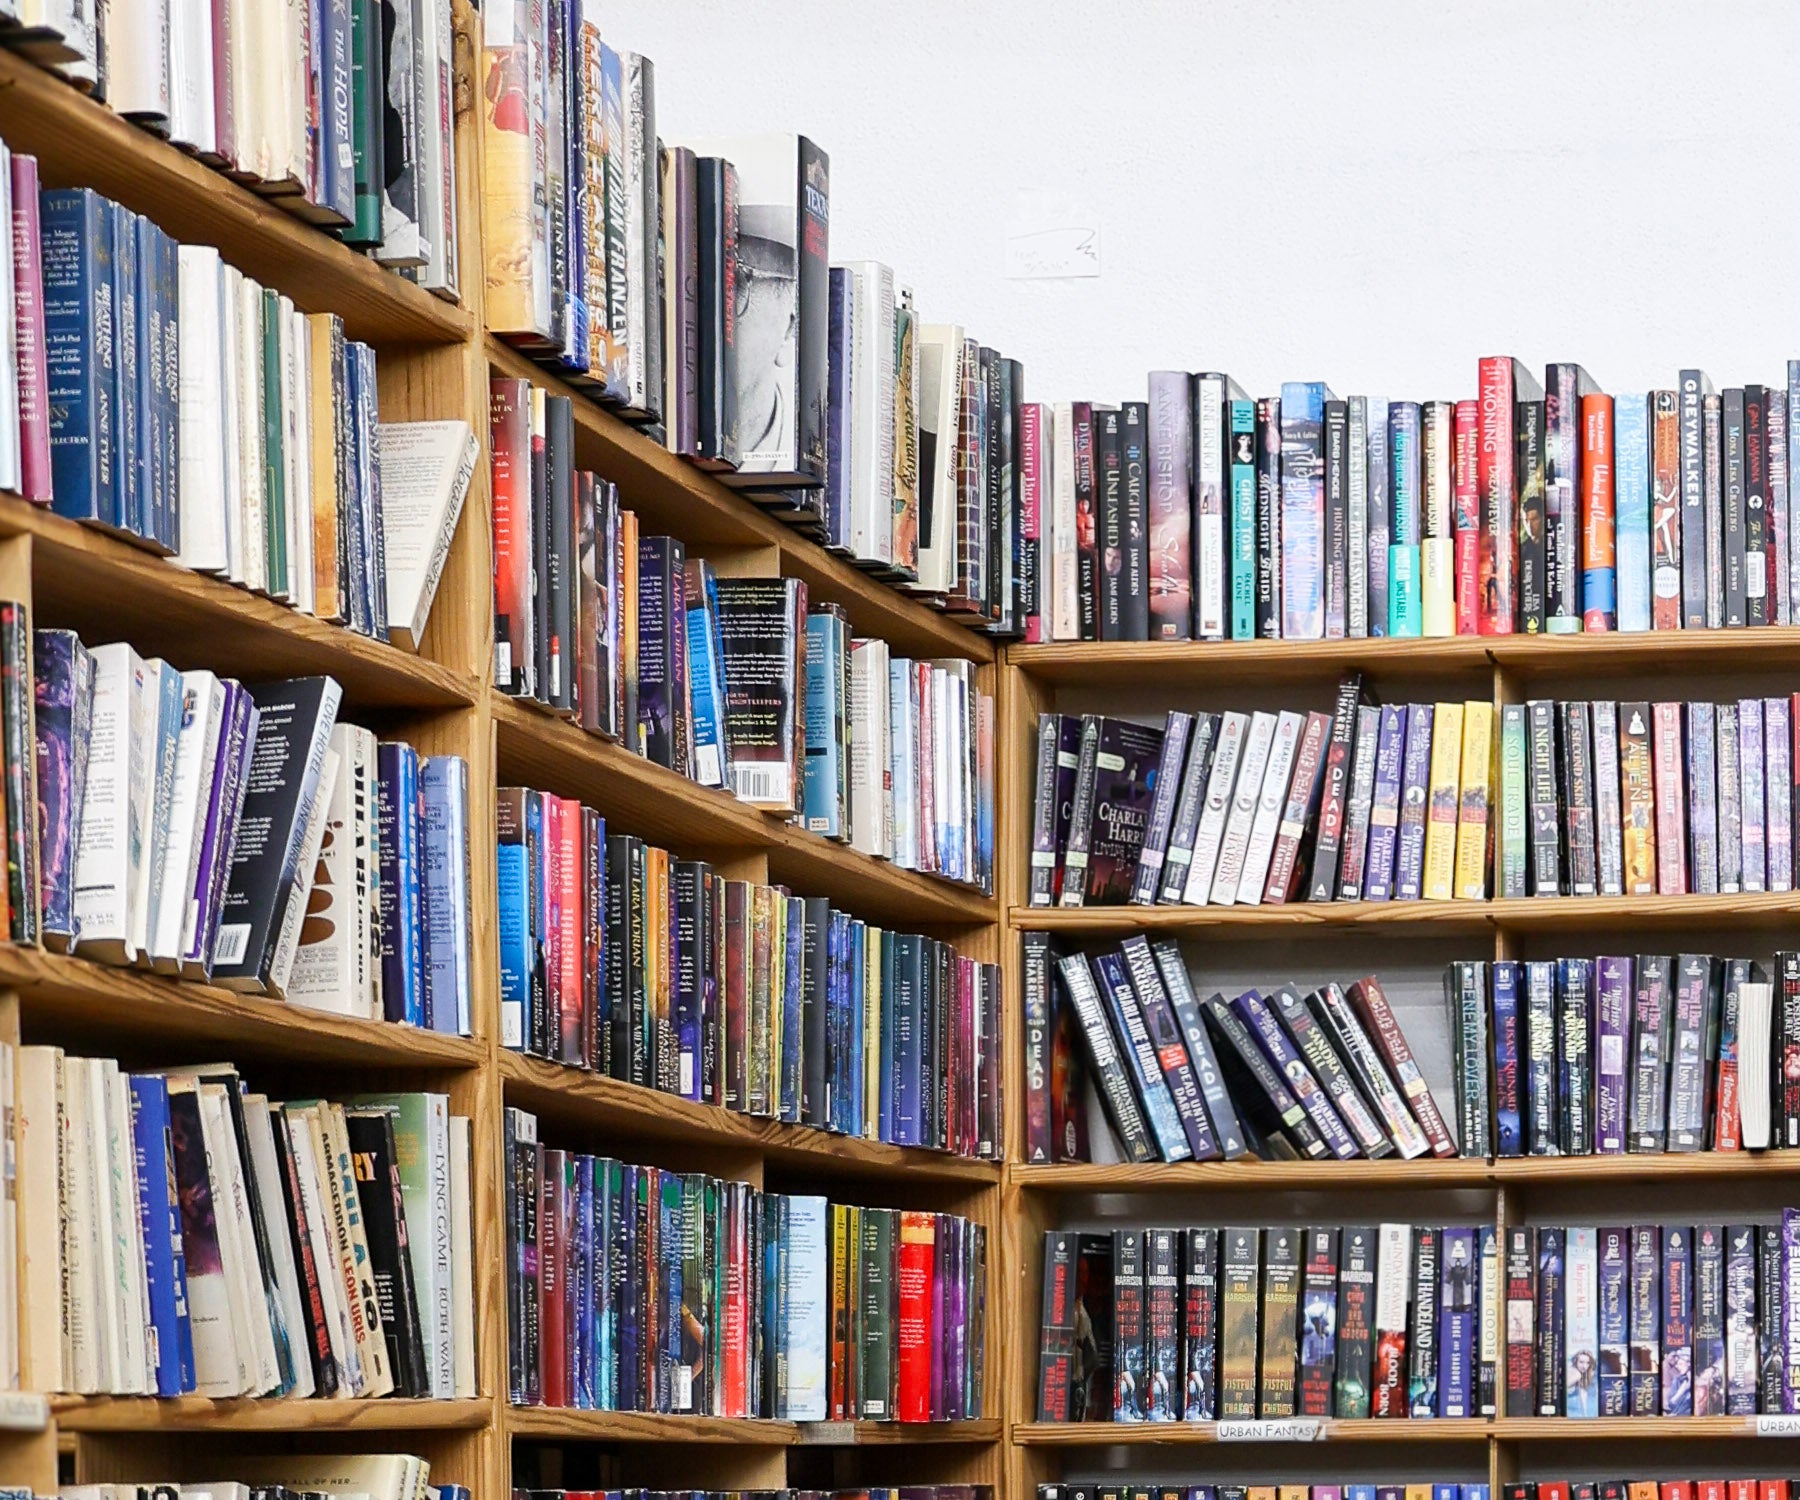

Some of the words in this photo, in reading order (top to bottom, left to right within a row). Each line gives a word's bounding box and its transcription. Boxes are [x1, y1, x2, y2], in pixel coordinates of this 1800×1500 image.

[611, 237, 628, 347] FRANZEN
[1684, 379, 1700, 507] GREYWALKER
[1105, 470, 1119, 547] UNLEASHED
[1628, 741, 1642, 803] ALIEN
[438, 1287, 448, 1332] RUTH
[439, 1340, 450, 1391] WARE
[1220, 1424, 1262, 1441] URBAN
